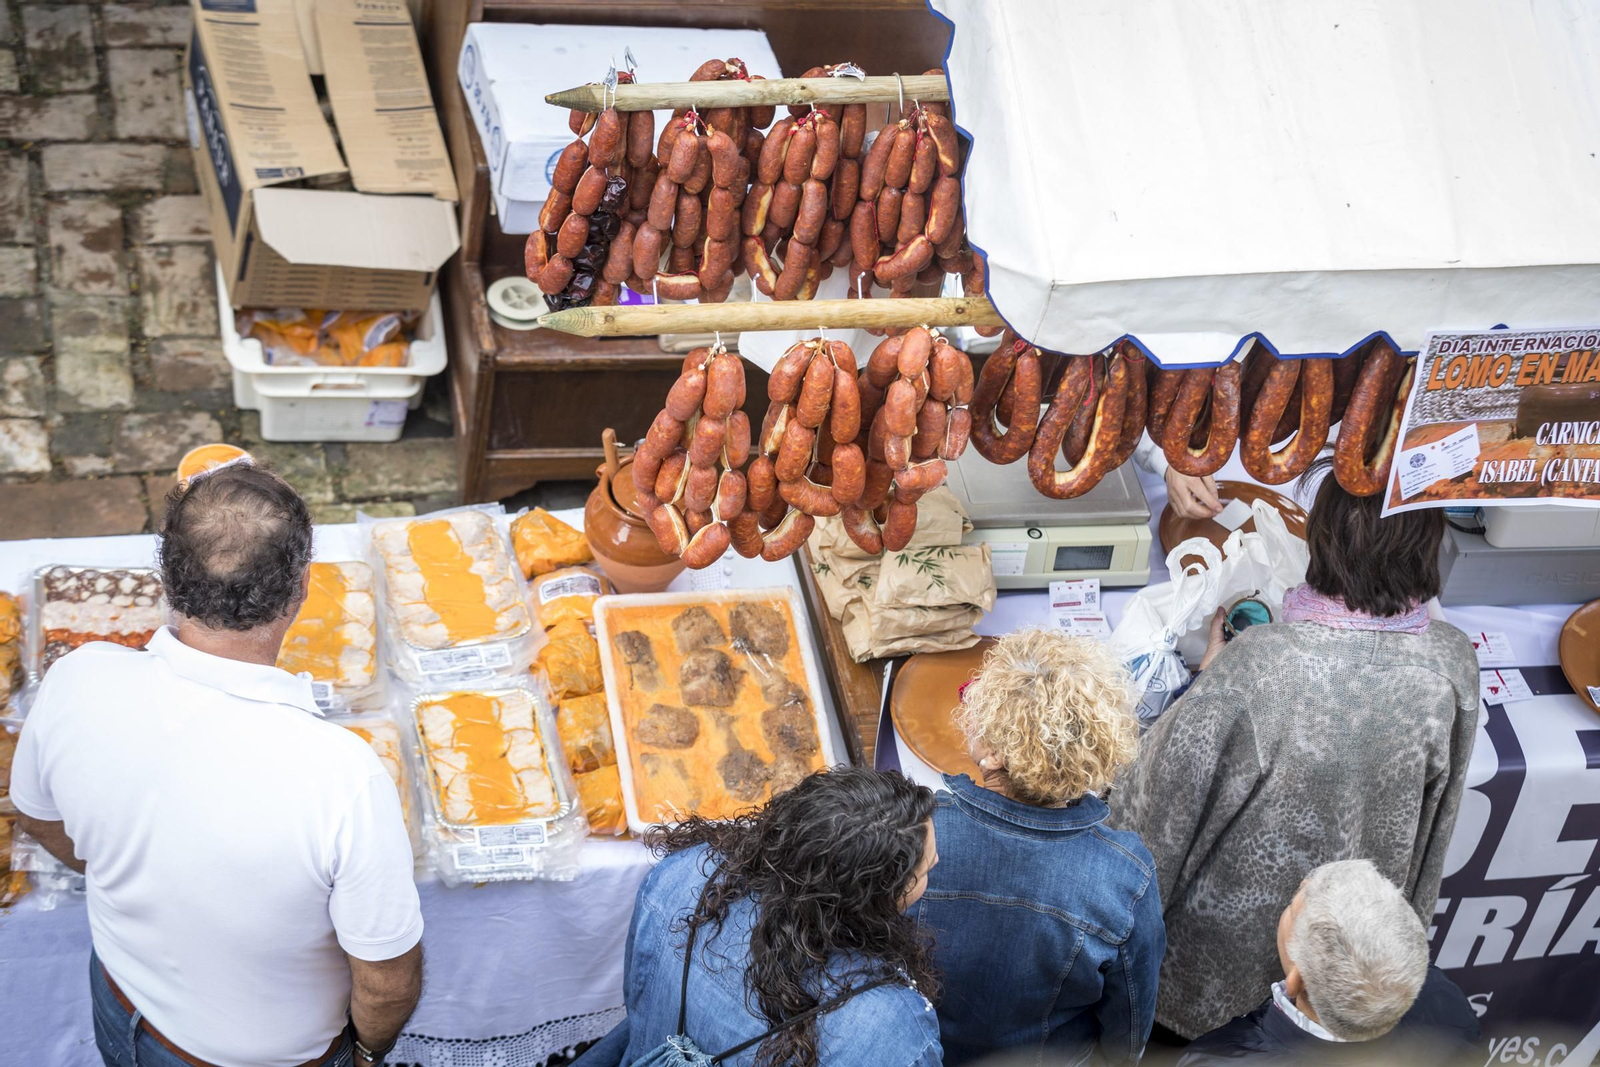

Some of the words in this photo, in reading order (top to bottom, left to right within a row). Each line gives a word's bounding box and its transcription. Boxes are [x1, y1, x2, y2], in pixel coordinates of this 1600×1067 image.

[1438, 340, 1471, 354] DIA
[1477, 335, 1600, 353] INTERNACIO
[1426, 353, 1513, 391] LOMO
[1515, 351, 1561, 386] EN
[1536, 420, 1600, 446] CARNIC
[1478, 459, 1538, 484] ISABEL
[1427, 873, 1600, 970] RÍA
